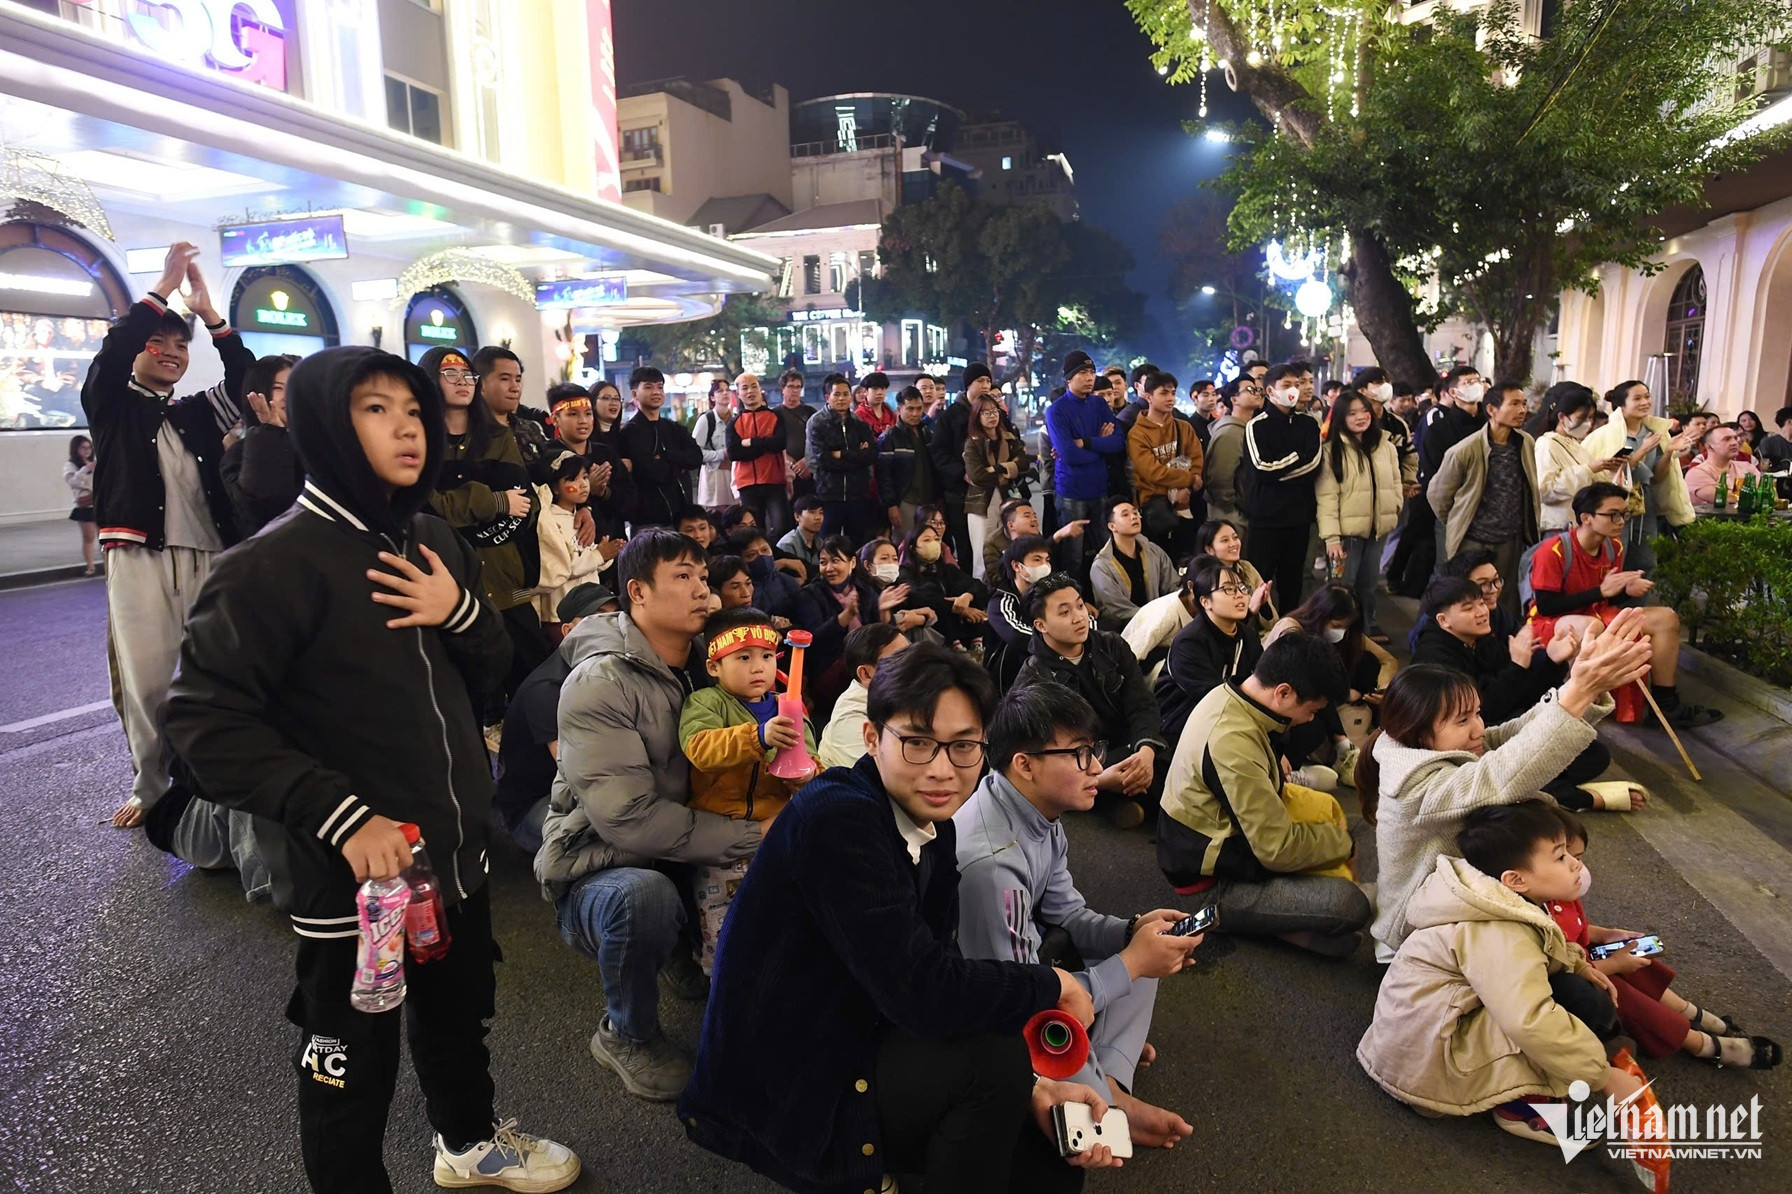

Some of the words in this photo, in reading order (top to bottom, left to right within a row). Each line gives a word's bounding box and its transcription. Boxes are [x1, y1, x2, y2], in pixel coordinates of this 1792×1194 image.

[493, 529, 510, 545] CUP
[750, 625, 763, 639] VÔ
[717, 631, 735, 650] NAM
